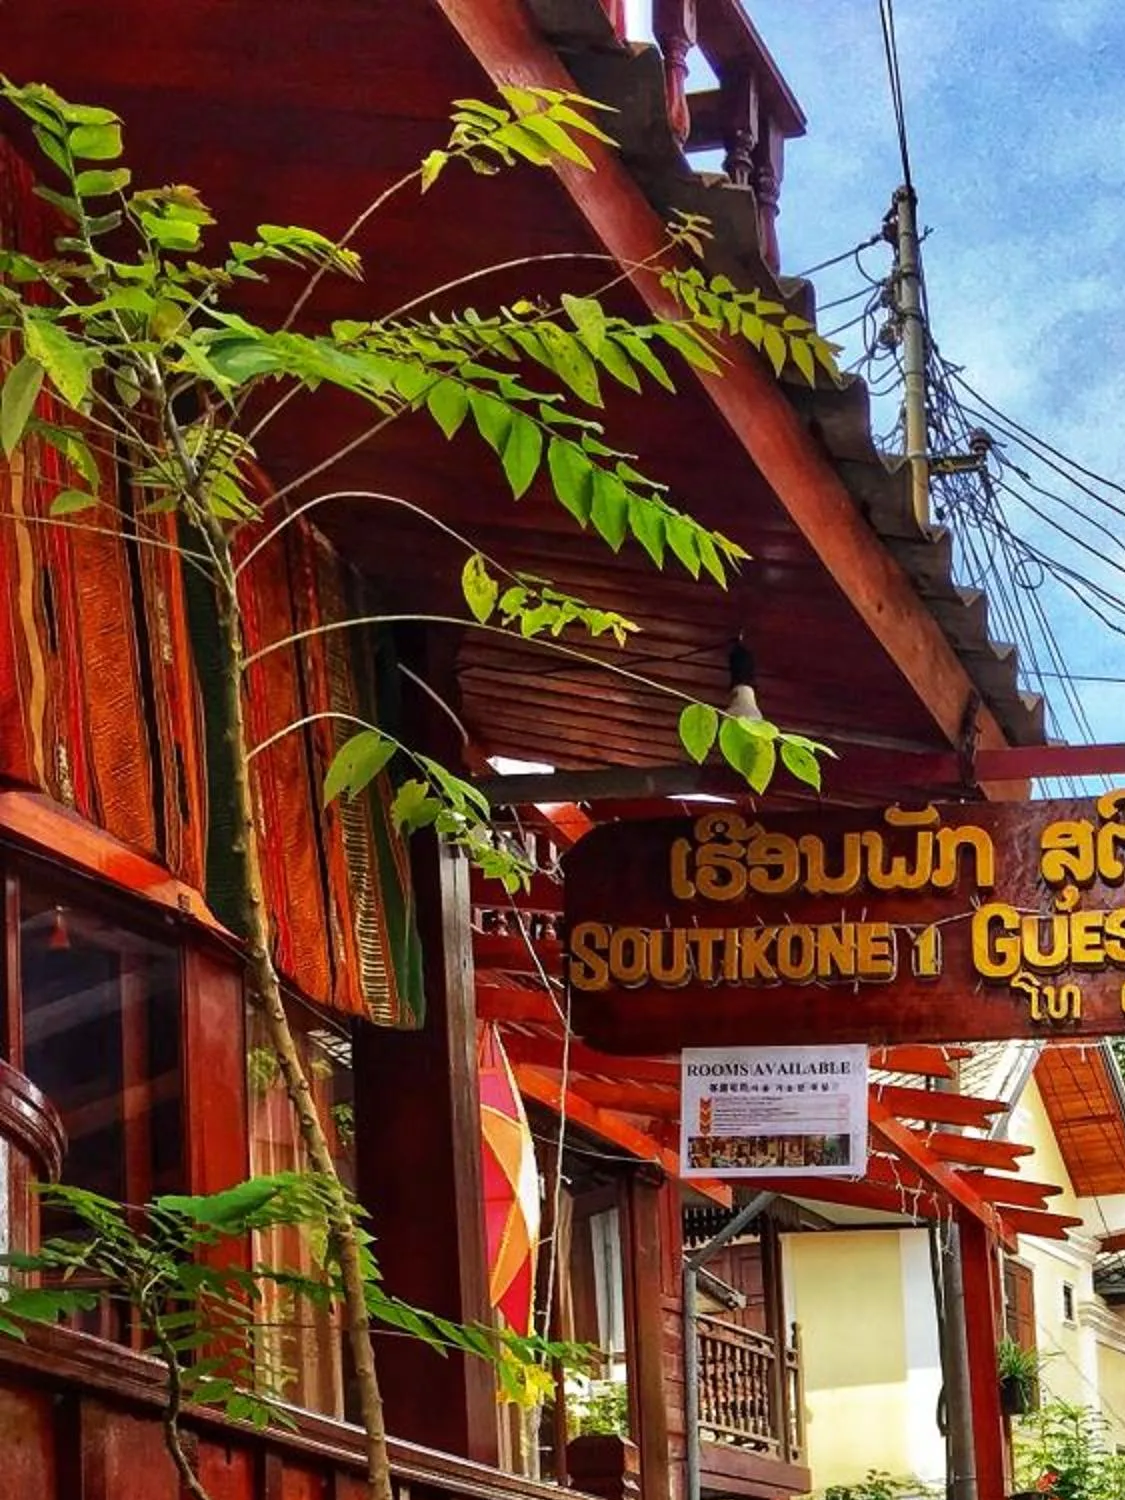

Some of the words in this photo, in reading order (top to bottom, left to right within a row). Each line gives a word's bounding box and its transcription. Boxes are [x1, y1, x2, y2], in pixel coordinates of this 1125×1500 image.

[569, 922, 891, 992] SOUTIKONE
[687, 1062, 749, 1077] ROOMS
[752, 1061, 851, 1077] AVAILABLE
